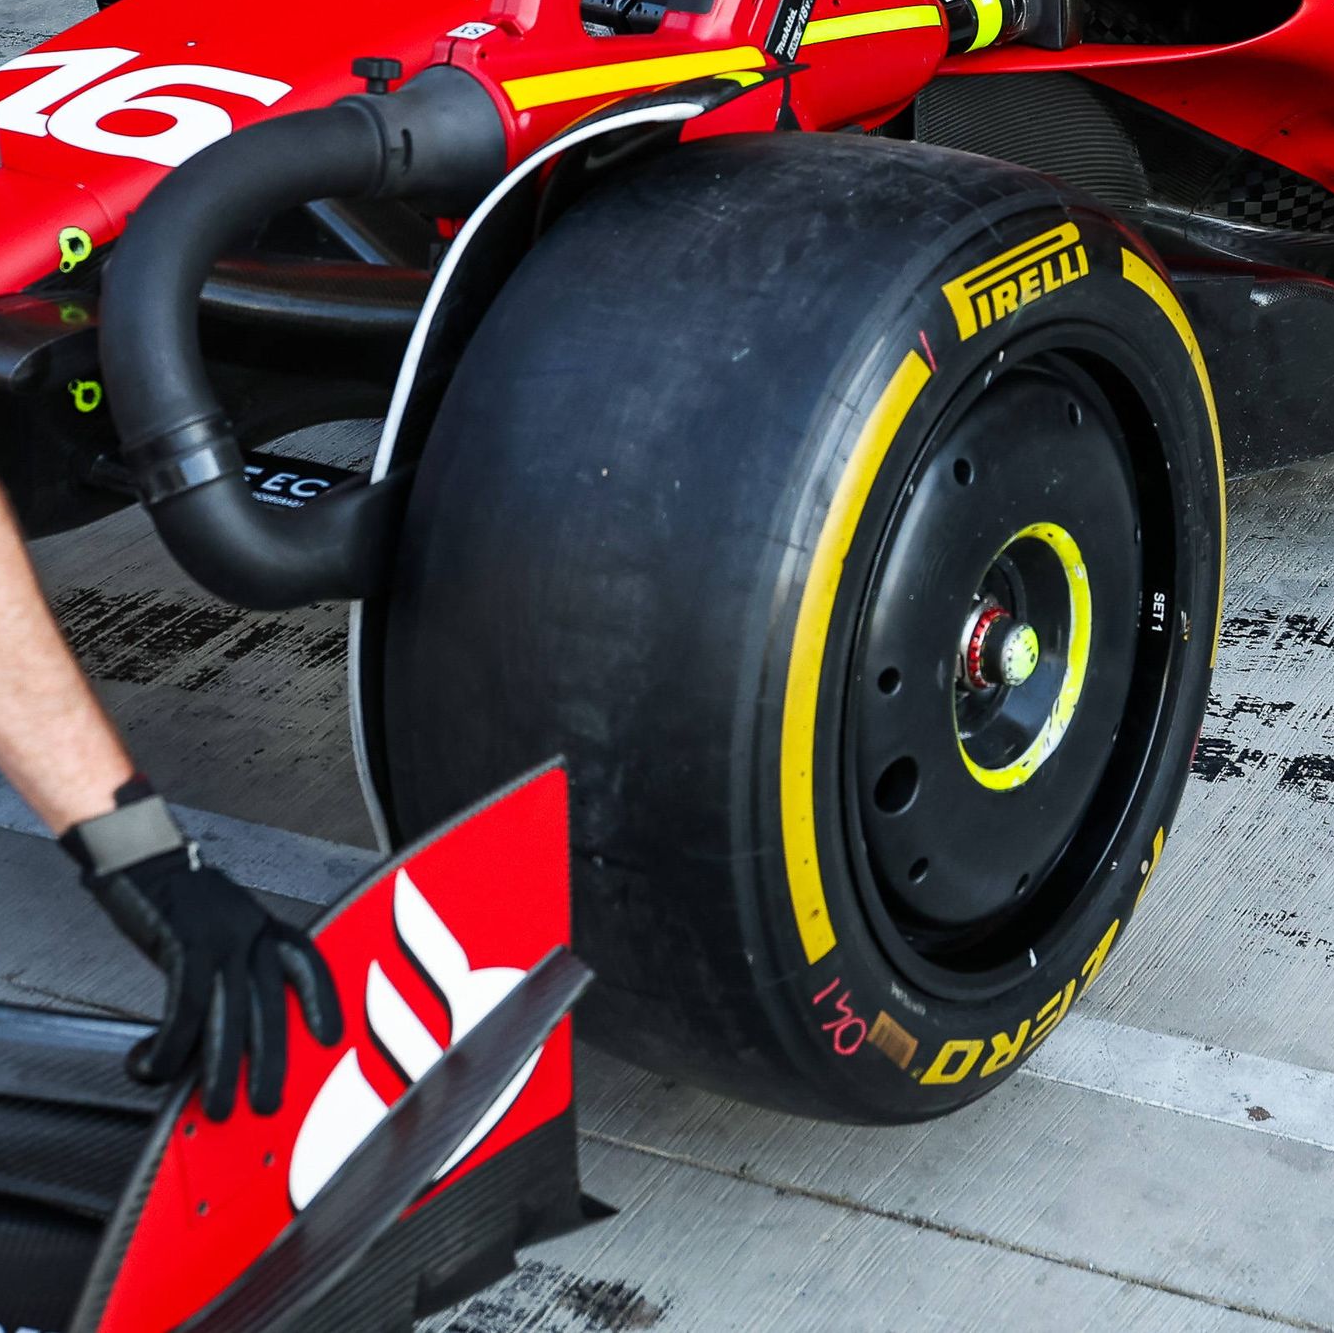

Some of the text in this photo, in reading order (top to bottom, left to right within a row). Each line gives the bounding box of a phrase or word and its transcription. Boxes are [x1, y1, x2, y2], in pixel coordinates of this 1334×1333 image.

[941, 221, 1089, 342] PIRELLI
[1151, 592, 1166, 632] SET 1
